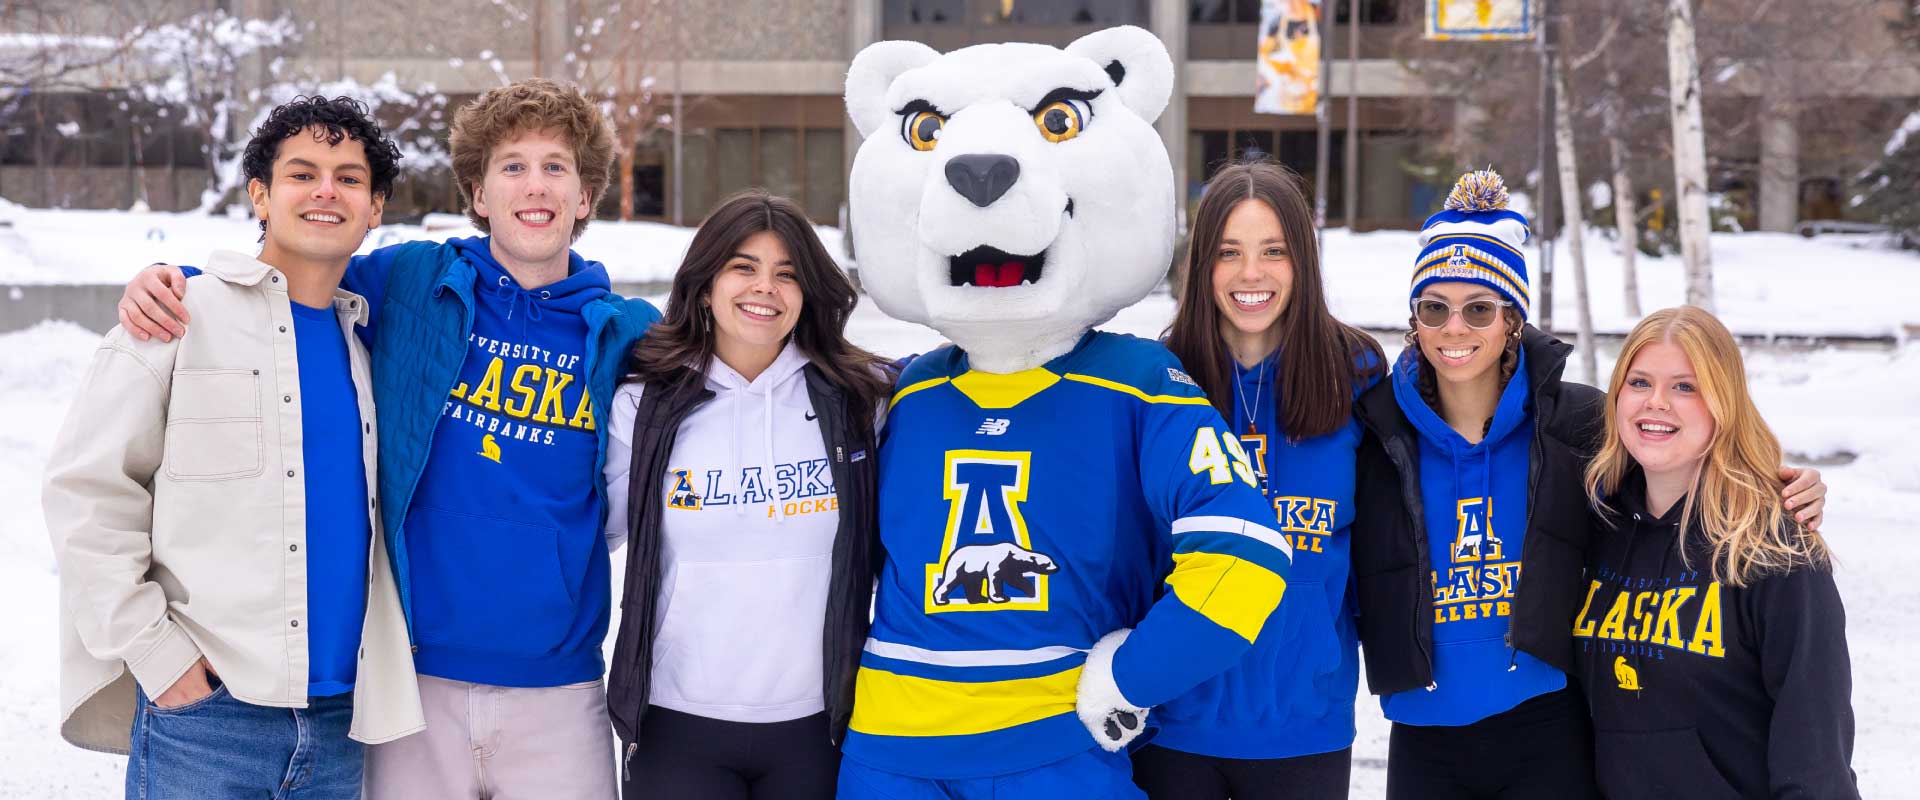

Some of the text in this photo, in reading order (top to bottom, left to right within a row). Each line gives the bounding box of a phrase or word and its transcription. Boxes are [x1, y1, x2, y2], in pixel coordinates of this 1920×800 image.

[557, 354, 579, 369] OF
[442, 401, 555, 445] FAIRBANKS
[667, 458, 836, 510] ALASK
[1189, 426, 1258, 488] 49
[925, 450, 1049, 614] A
[1572, 579, 1727, 659] LASKA
